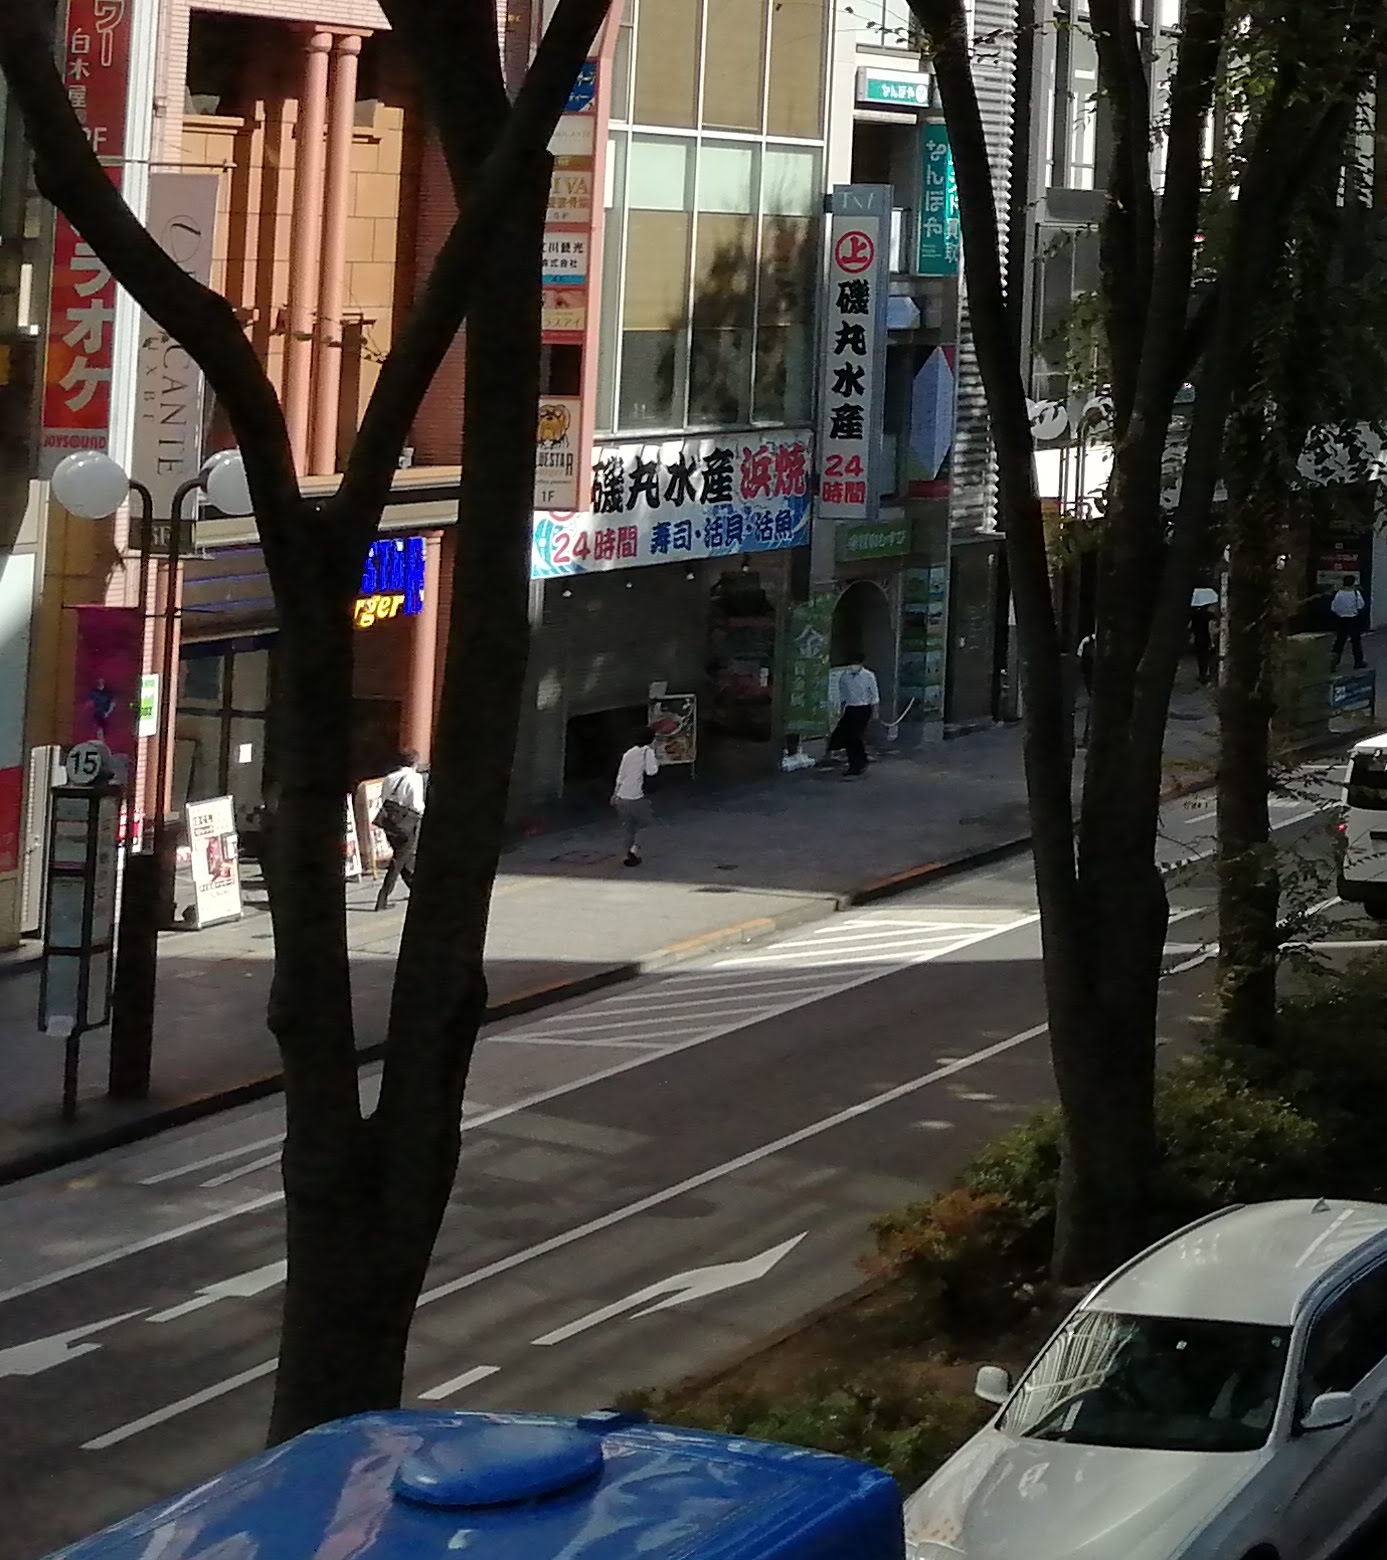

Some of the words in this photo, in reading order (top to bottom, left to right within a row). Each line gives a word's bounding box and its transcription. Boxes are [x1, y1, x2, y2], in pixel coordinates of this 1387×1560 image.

[71, 27, 91, 108] 白木屋
[922, 139, 947, 239] なんぼや
[58, 224, 116, 413] ラオケ
[829, 278, 871, 441] 磯丸水産
[592, 447, 735, 515] 磯丸水産
[822, 480, 866, 505] 時間
[824, 454, 865, 478] 24
[541, 489, 556, 502] 1F
[552, 524, 639, 564] 24時間
[71, 751, 99, 776] 15
